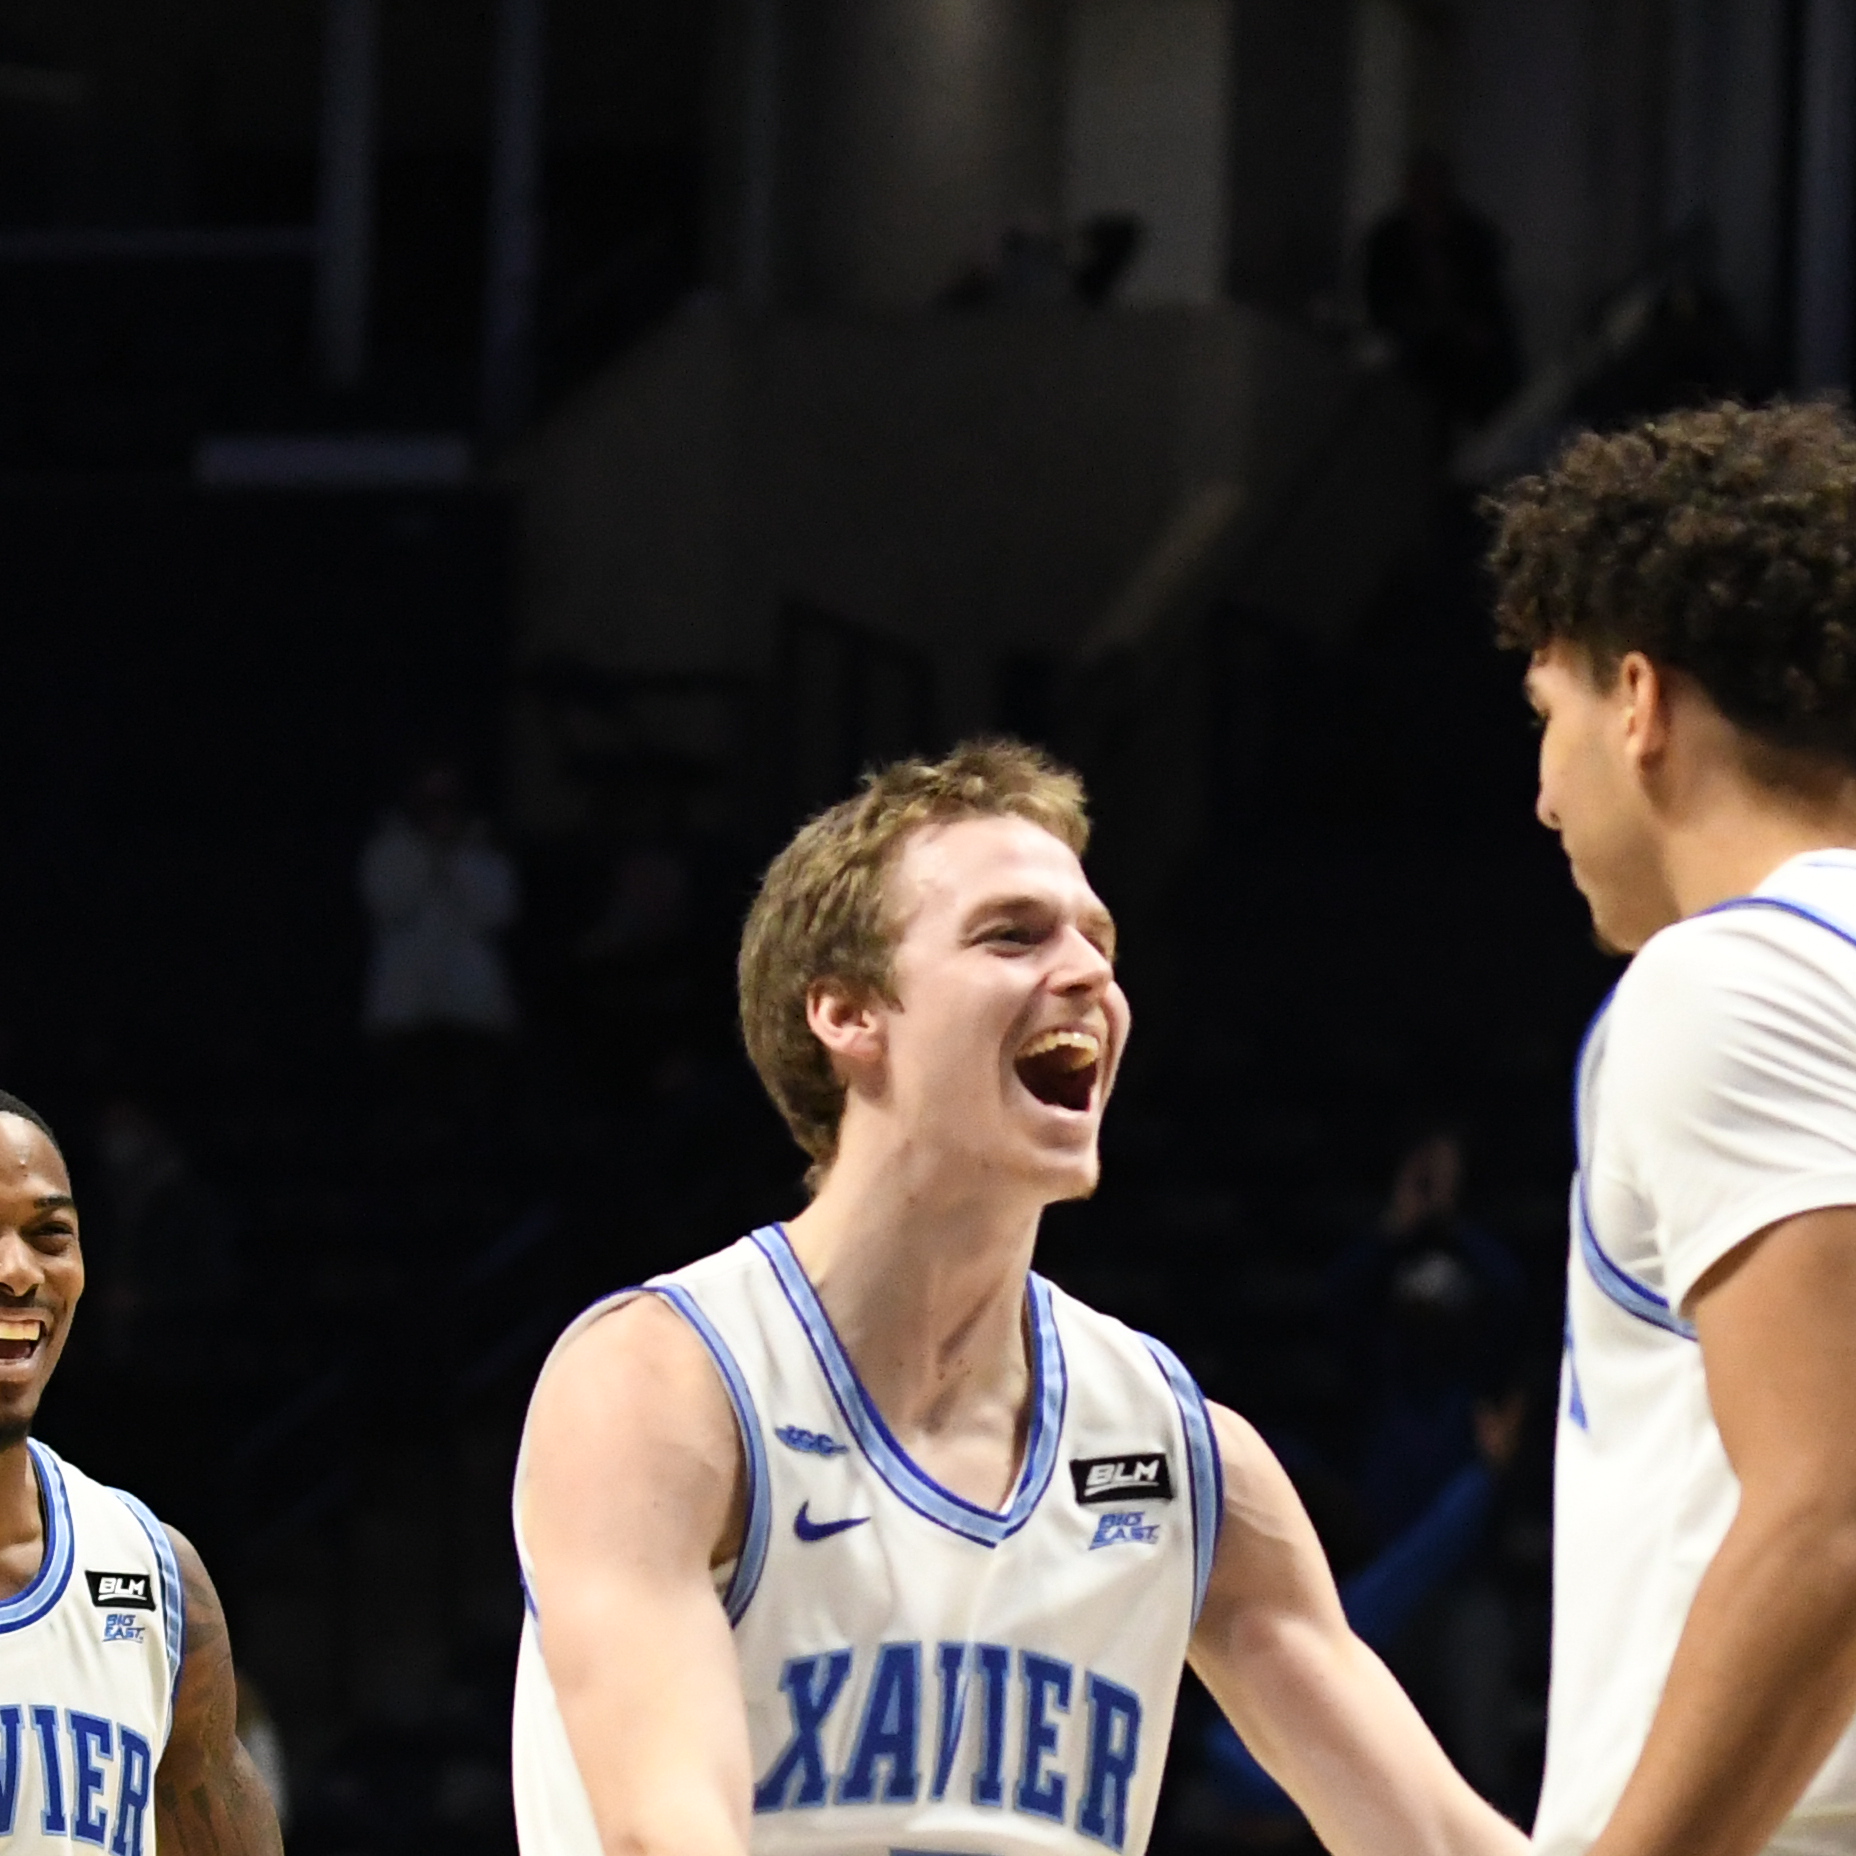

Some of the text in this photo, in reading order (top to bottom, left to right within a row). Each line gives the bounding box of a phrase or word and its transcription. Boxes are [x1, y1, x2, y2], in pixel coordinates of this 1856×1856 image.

[1085, 1459, 1160, 1487] BLM
[1099, 1511, 1146, 1527] BIG
[98, 1576, 146, 1596] BLM
[105, 1613, 137, 1627] BIG
[752, 1640, 1143, 1856] XAVIER
